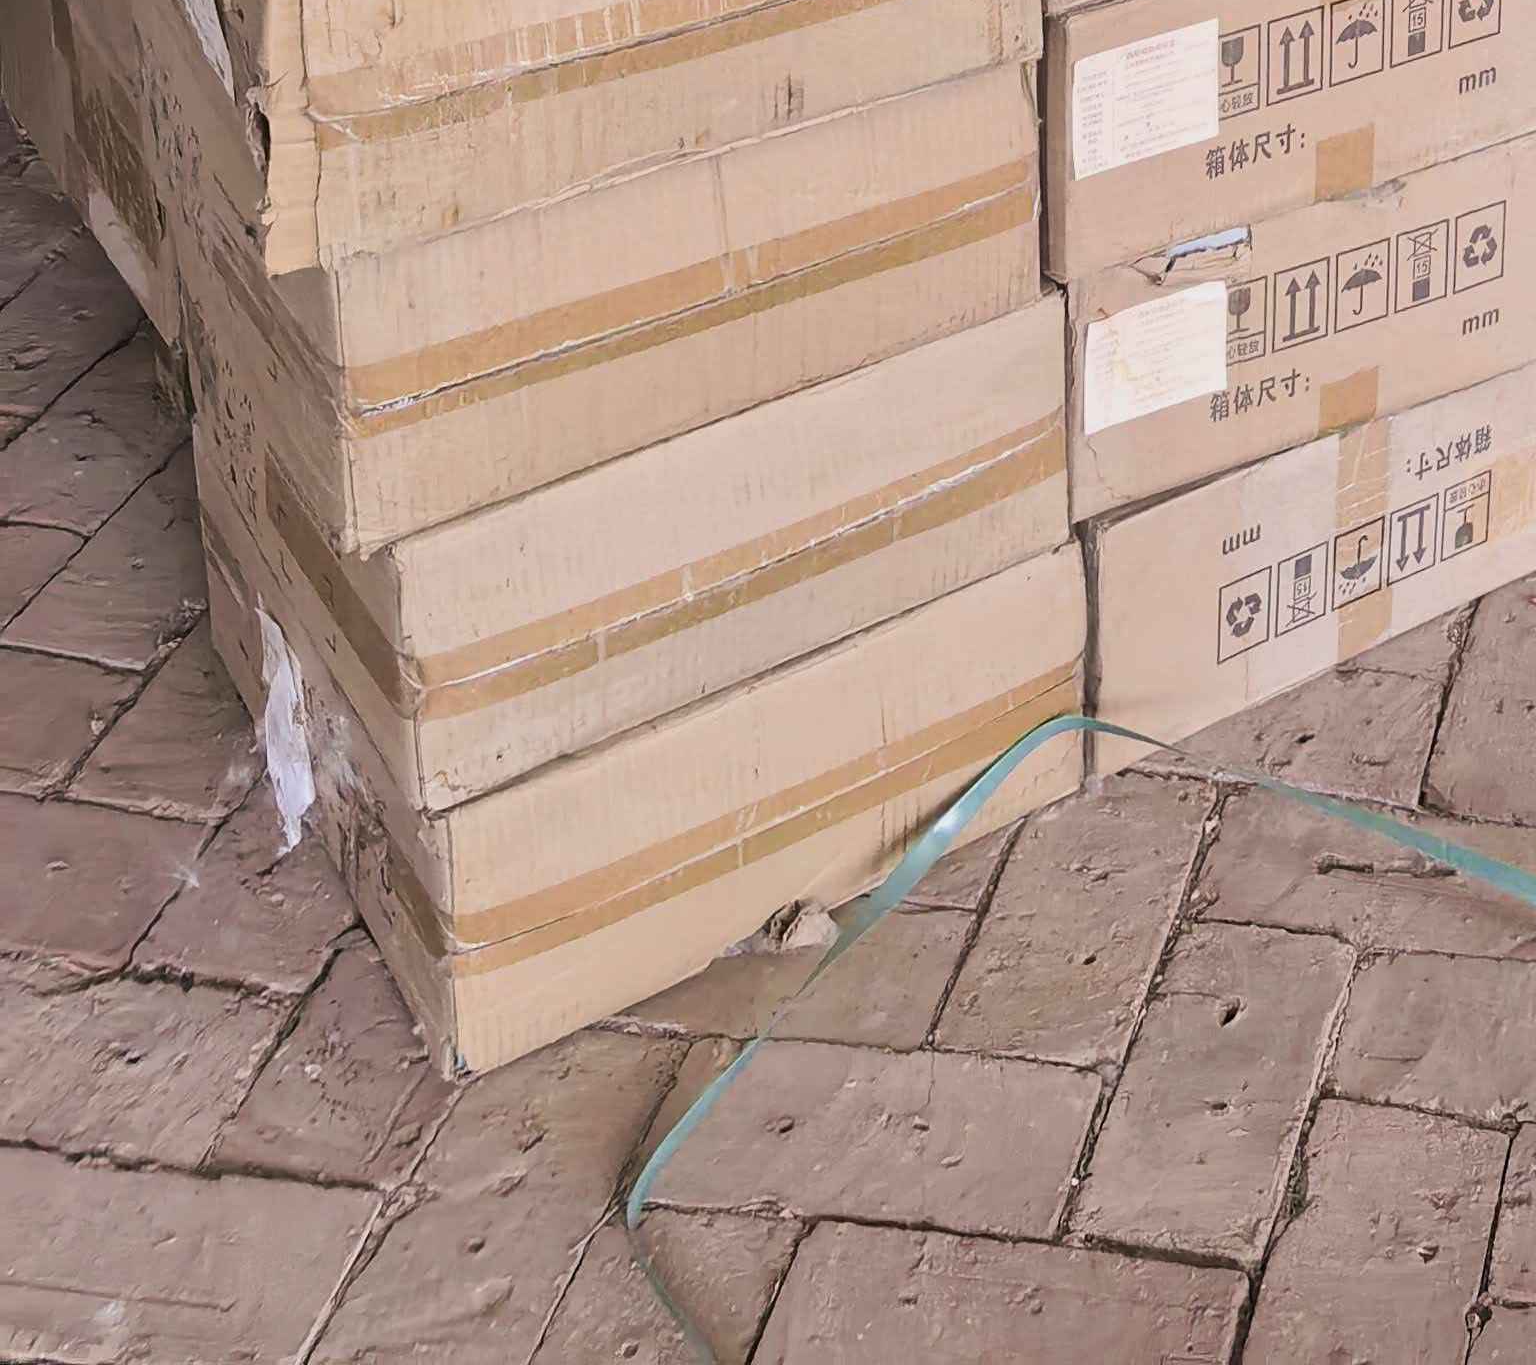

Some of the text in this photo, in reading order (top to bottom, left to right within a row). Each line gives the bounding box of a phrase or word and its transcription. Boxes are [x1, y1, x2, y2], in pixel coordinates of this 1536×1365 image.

[1458, 66, 1497, 95] mm
[1206, 126, 1306, 180] 箱体尺寸:
[1462, 309, 1500, 336] mm
[1210, 369, 1311, 423] 箱体尺寸:
[1406, 426, 1493, 479] 箱体尺寸:
[1221, 523, 1262, 555] mm
